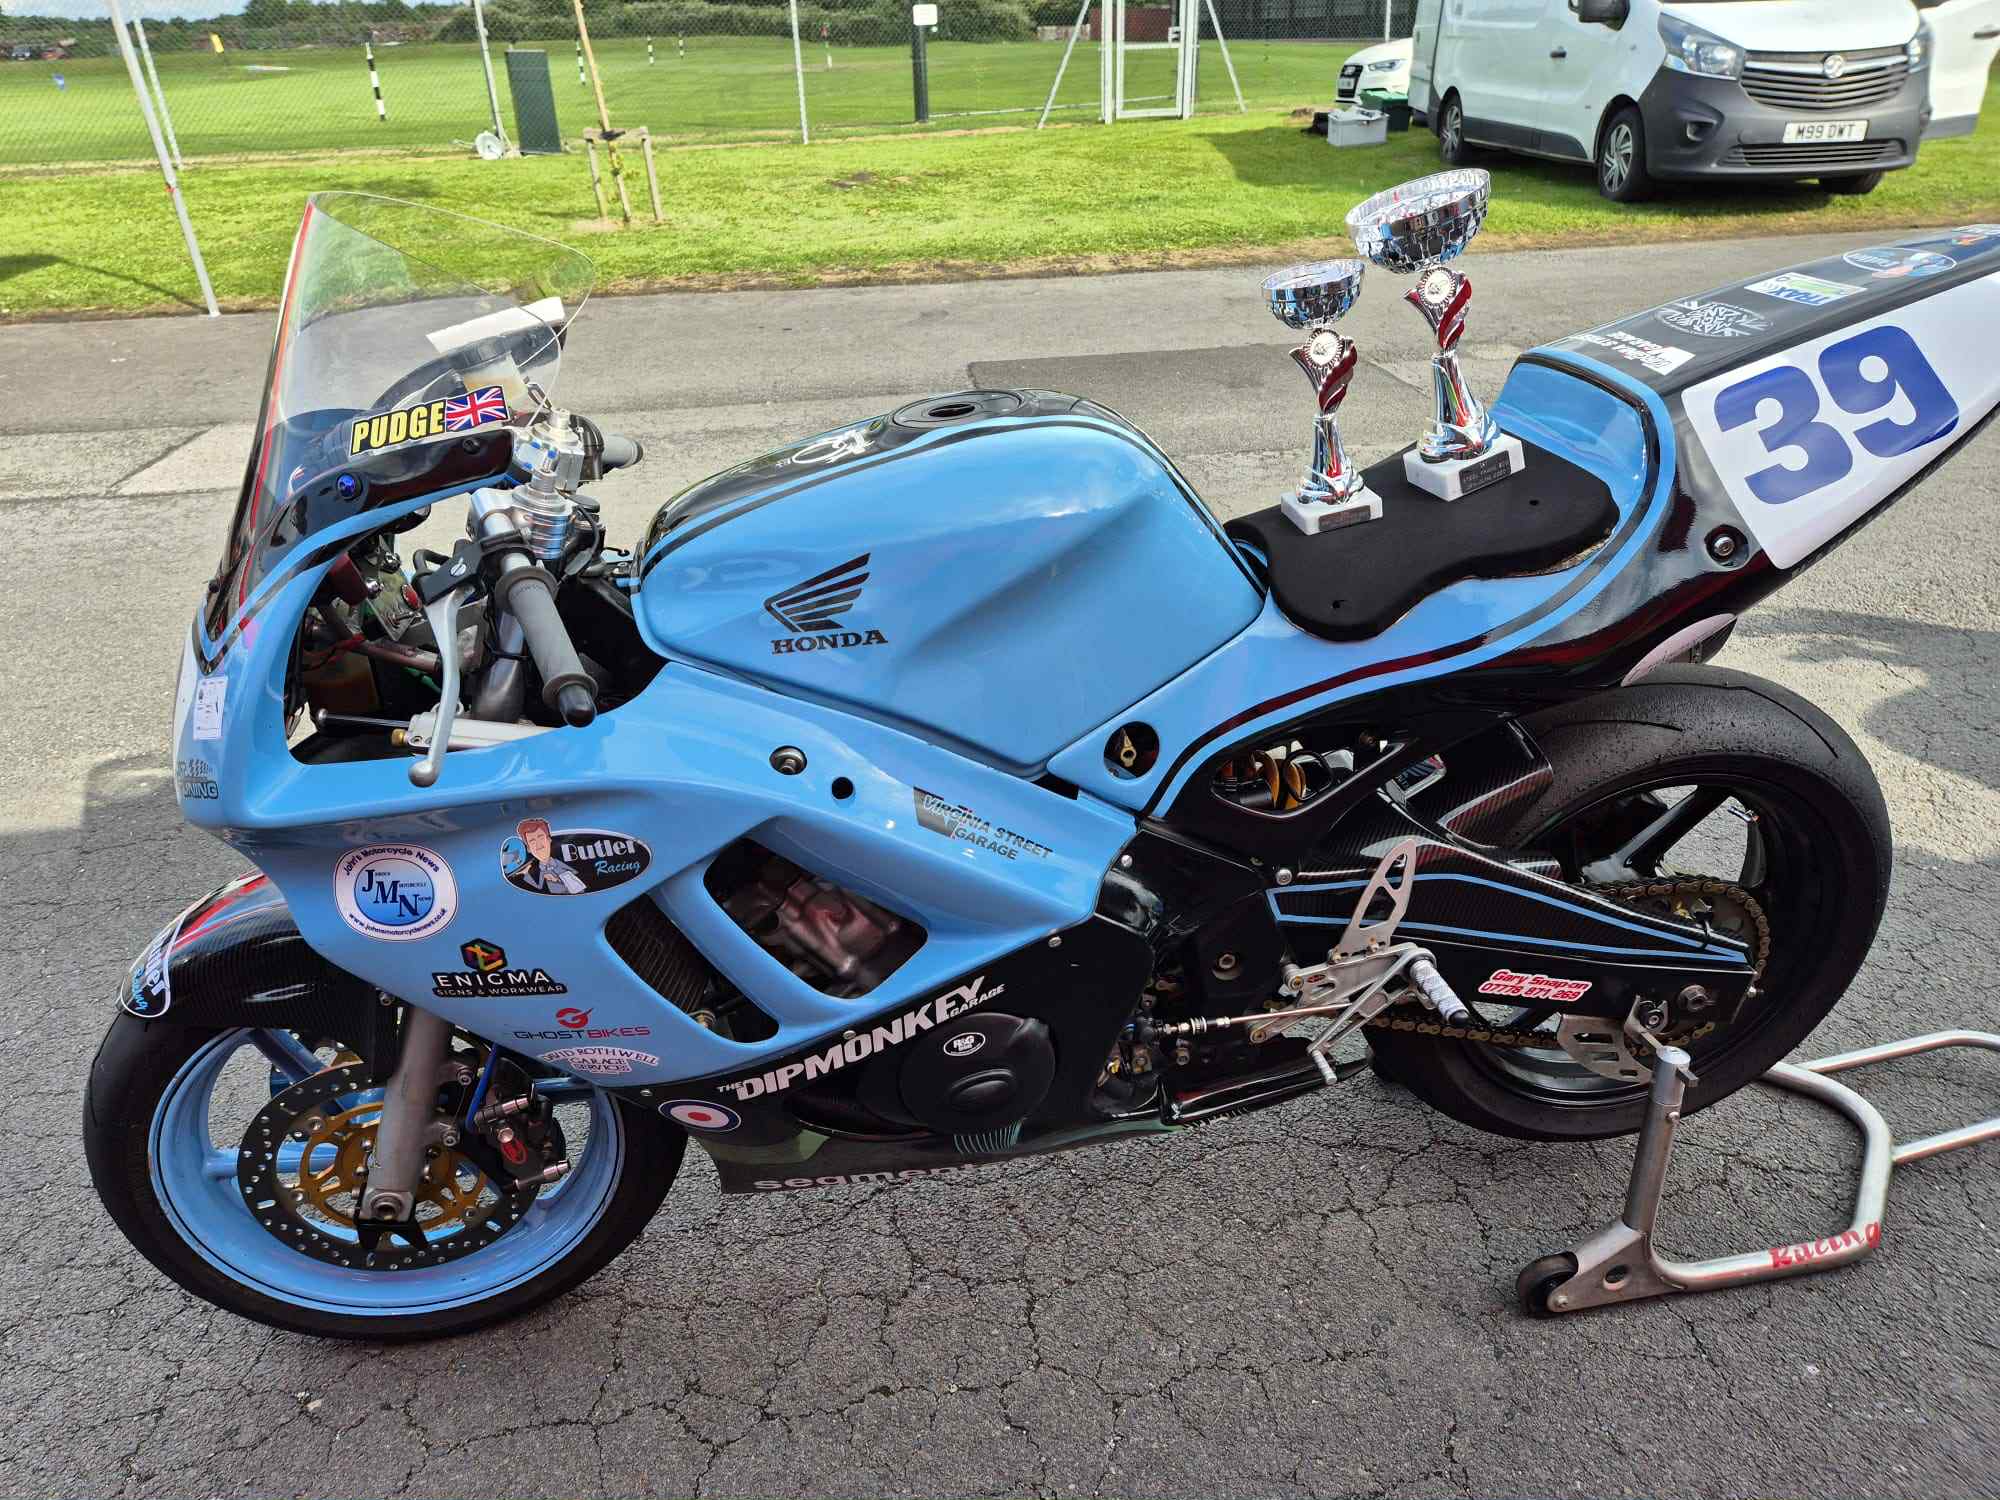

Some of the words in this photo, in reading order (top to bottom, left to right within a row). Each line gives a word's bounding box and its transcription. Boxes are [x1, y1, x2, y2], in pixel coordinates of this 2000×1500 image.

[351, 401, 446, 454] PUDGE
[1714, 325, 1959, 505] 39
[770, 629, 889, 655] HONDA
[923, 794, 991, 834] VIRGINIA
[995, 827, 1054, 859] STREET
[560, 838, 636, 862] Butler
[955, 827, 1019, 860] GARAGE
[415, 851, 441, 874] News
[594, 860, 641, 877] Racing
[436, 970, 550, 987] ENIGMA
[436, 988, 474, 996] SIGNS
[488, 985, 565, 995] WORKWEAR
[1493, 970, 1528, 986] Gary
[716, 1080, 745, 1095] THE
[736, 975, 987, 1101] DIPMONKEY
[949, 983, 1006, 1018] GARAGE
[1768, 1221, 1882, 1268] Racing
